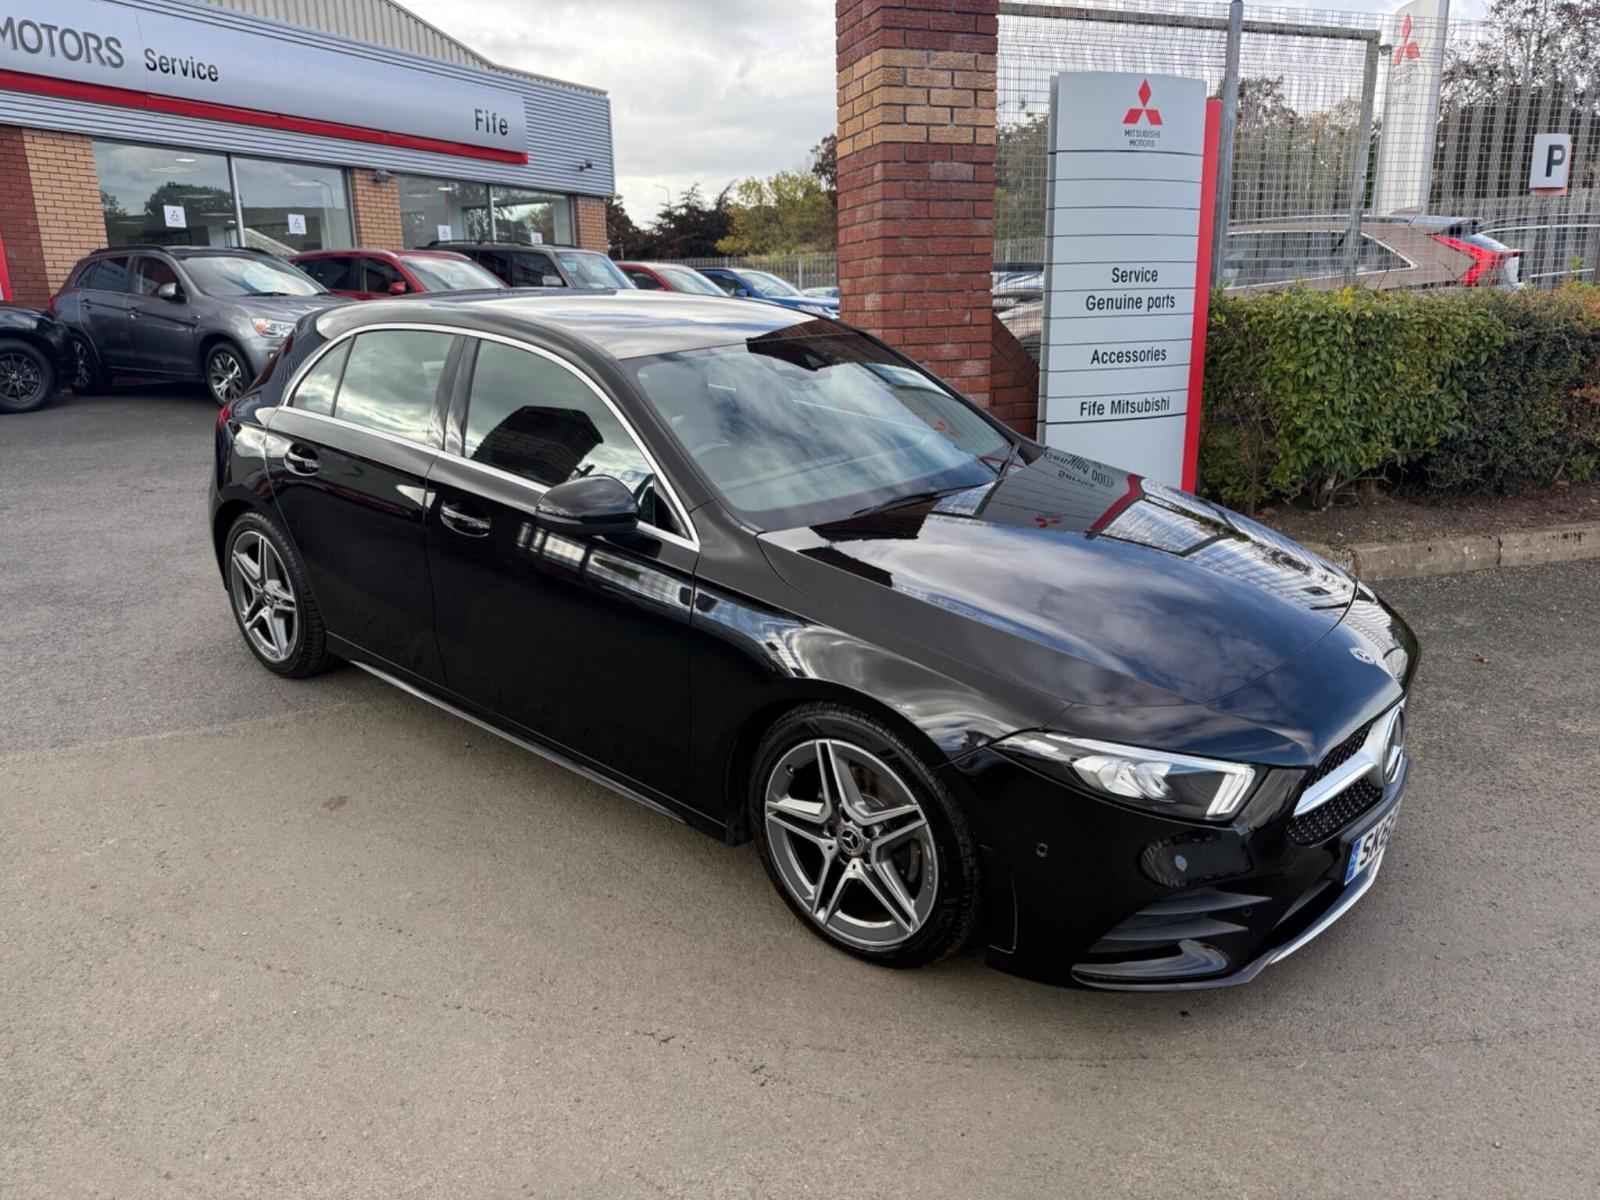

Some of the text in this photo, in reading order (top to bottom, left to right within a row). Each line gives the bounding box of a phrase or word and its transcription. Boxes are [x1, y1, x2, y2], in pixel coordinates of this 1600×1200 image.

[0, 16, 219, 82] MOTORS Service
[474, 108, 508, 136] Fife
[1545, 144, 1566, 178] P
[1111, 266, 1159, 283] Service
[1085, 293, 1175, 312] Genuine parts
[1090, 346, 1167, 365] Accessories
[1080, 396, 1170, 416] Fife Mitsubishi
